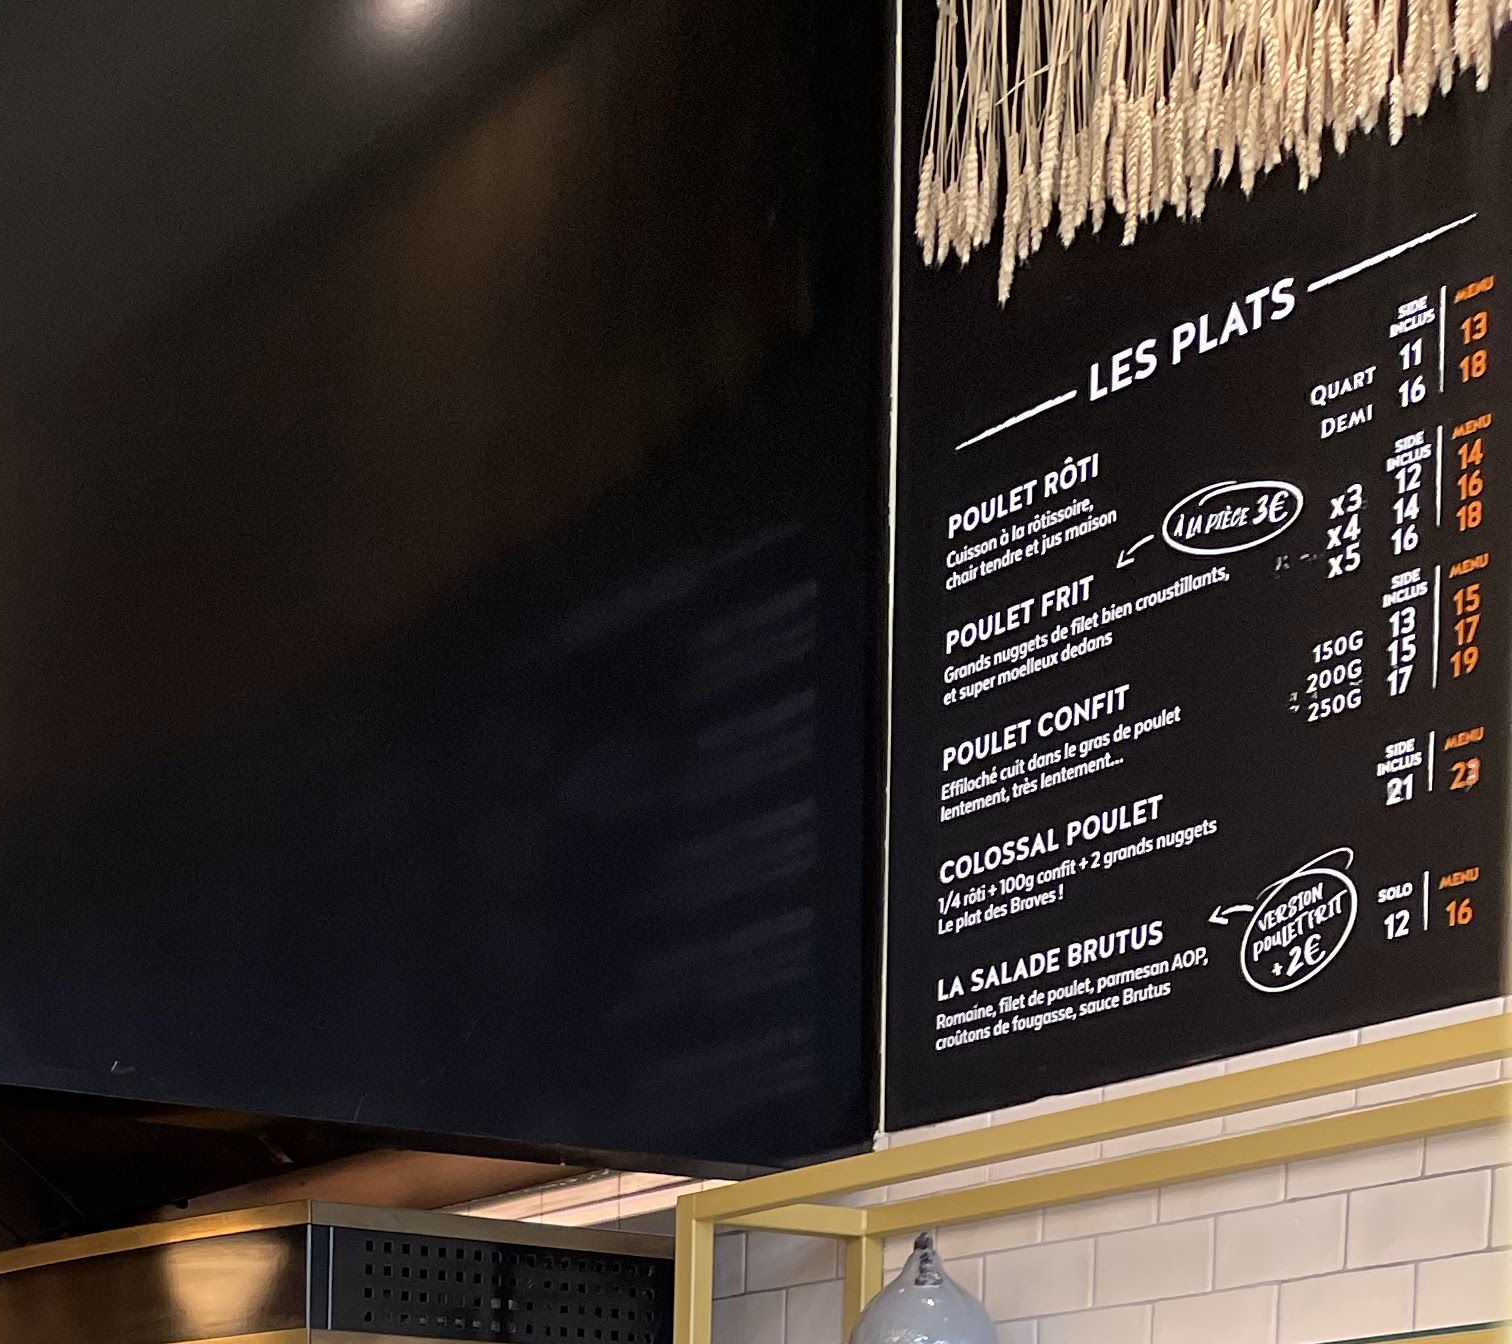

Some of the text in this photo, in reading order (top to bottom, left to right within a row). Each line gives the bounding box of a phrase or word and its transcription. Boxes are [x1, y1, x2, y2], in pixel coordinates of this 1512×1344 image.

[1454, 275, 1495, 304] MENU
[1389, 308, 1436, 338] INCLUS
[1398, 295, 1428, 319] SIDE
[1090, 277, 1296, 401] LES PLATS
[1460, 311, 1488, 344] 13
[1399, 338, 1423, 370] 11
[1459, 349, 1487, 382] 18
[1310, 366, 1377, 406] QUART
[1398, 375, 1426, 408] 16
[1320, 404, 1373, 439] DEMI
[1452, 413, 1493, 440] MENU
[1386, 444, 1432, 472] INCLUS
[1394, 430, 1425, 454] SIDE
[1458, 438, 1484, 470] 14
[1395, 463, 1422, 494] 12
[1457, 469, 1484, 500] 16
[948, 453, 1099, 539] POULET RÔTI
[1330, 484, 1363, 520] x3
[1393, 493, 1420, 524] 14
[1174, 490, 1289, 540] À LA PIÈCE 3€
[1456, 500, 1483, 532] 18
[946, 498, 1094, 568] Cuisson à la rôtissoire,
[1326, 514, 1362, 550] x4
[1391, 524, 1419, 555] 16
[946, 509, 1117, 590] chair tendre et jus maison
[1327, 542, 1362, 578] x5
[1448, 553, 1489, 578] MENU
[1382, 581, 1428, 608] INCLUS
[1391, 568, 1421, 590] SIDE
[946, 575, 1094, 654] POULET FRIT
[1453, 584, 1481, 616] 15
[944, 566, 1230, 684] Grands nuggets de filet bien croustillants,
[1389, 606, 1416, 638] 13
[1454, 614, 1480, 646] 17
[1312, 630, 1364, 664] 150G
[1388, 634, 1417, 666] 15
[1450, 646, 1479, 678] 19
[943, 631, 1113, 706] et super moelleux dedans
[1306, 658, 1363, 694] 200G
[1386, 664, 1414, 696] 17
[1307, 688, 1362, 722] 250G
[942, 684, 1130, 772] POULET CONFIT
[1444, 726, 1485, 750] MENU
[941, 706, 1182, 800] Effiloché cuit dans le gras de poulet
[1376, 752, 1422, 777] INCLUS
[1386, 738, 1415, 758] SIDE
[940, 752, 1124, 822] lentement, très lentement...
[1386, 774, 1414, 806] 21
[1449, 757, 1481, 790] 23
[939, 794, 1164, 884] COLOSSAL POULET
[938, 818, 1218, 915] 1/4 rôti + 100g confit + 2 grands nuggets
[1438, 866, 1480, 890] MENU
[1258, 882, 1324, 932] VERSION
[1378, 882, 1413, 903] SOLO
[938, 884, 1064, 935] Le plat des Braves !
[1253, 889, 1348, 962] POULET FRIT
[1384, 910, 1410, 940] 12
[1445, 898, 1473, 926] 16
[938, 920, 1164, 1002] LA SALADE BRUTUS
[1271, 934, 1326, 976] + 2€
[936, 946, 1209, 1030] Romaine, filet de poulet, parmesan AOP,
[935, 981, 1172, 1051] croûtons de fougasse, sauce Brutus
